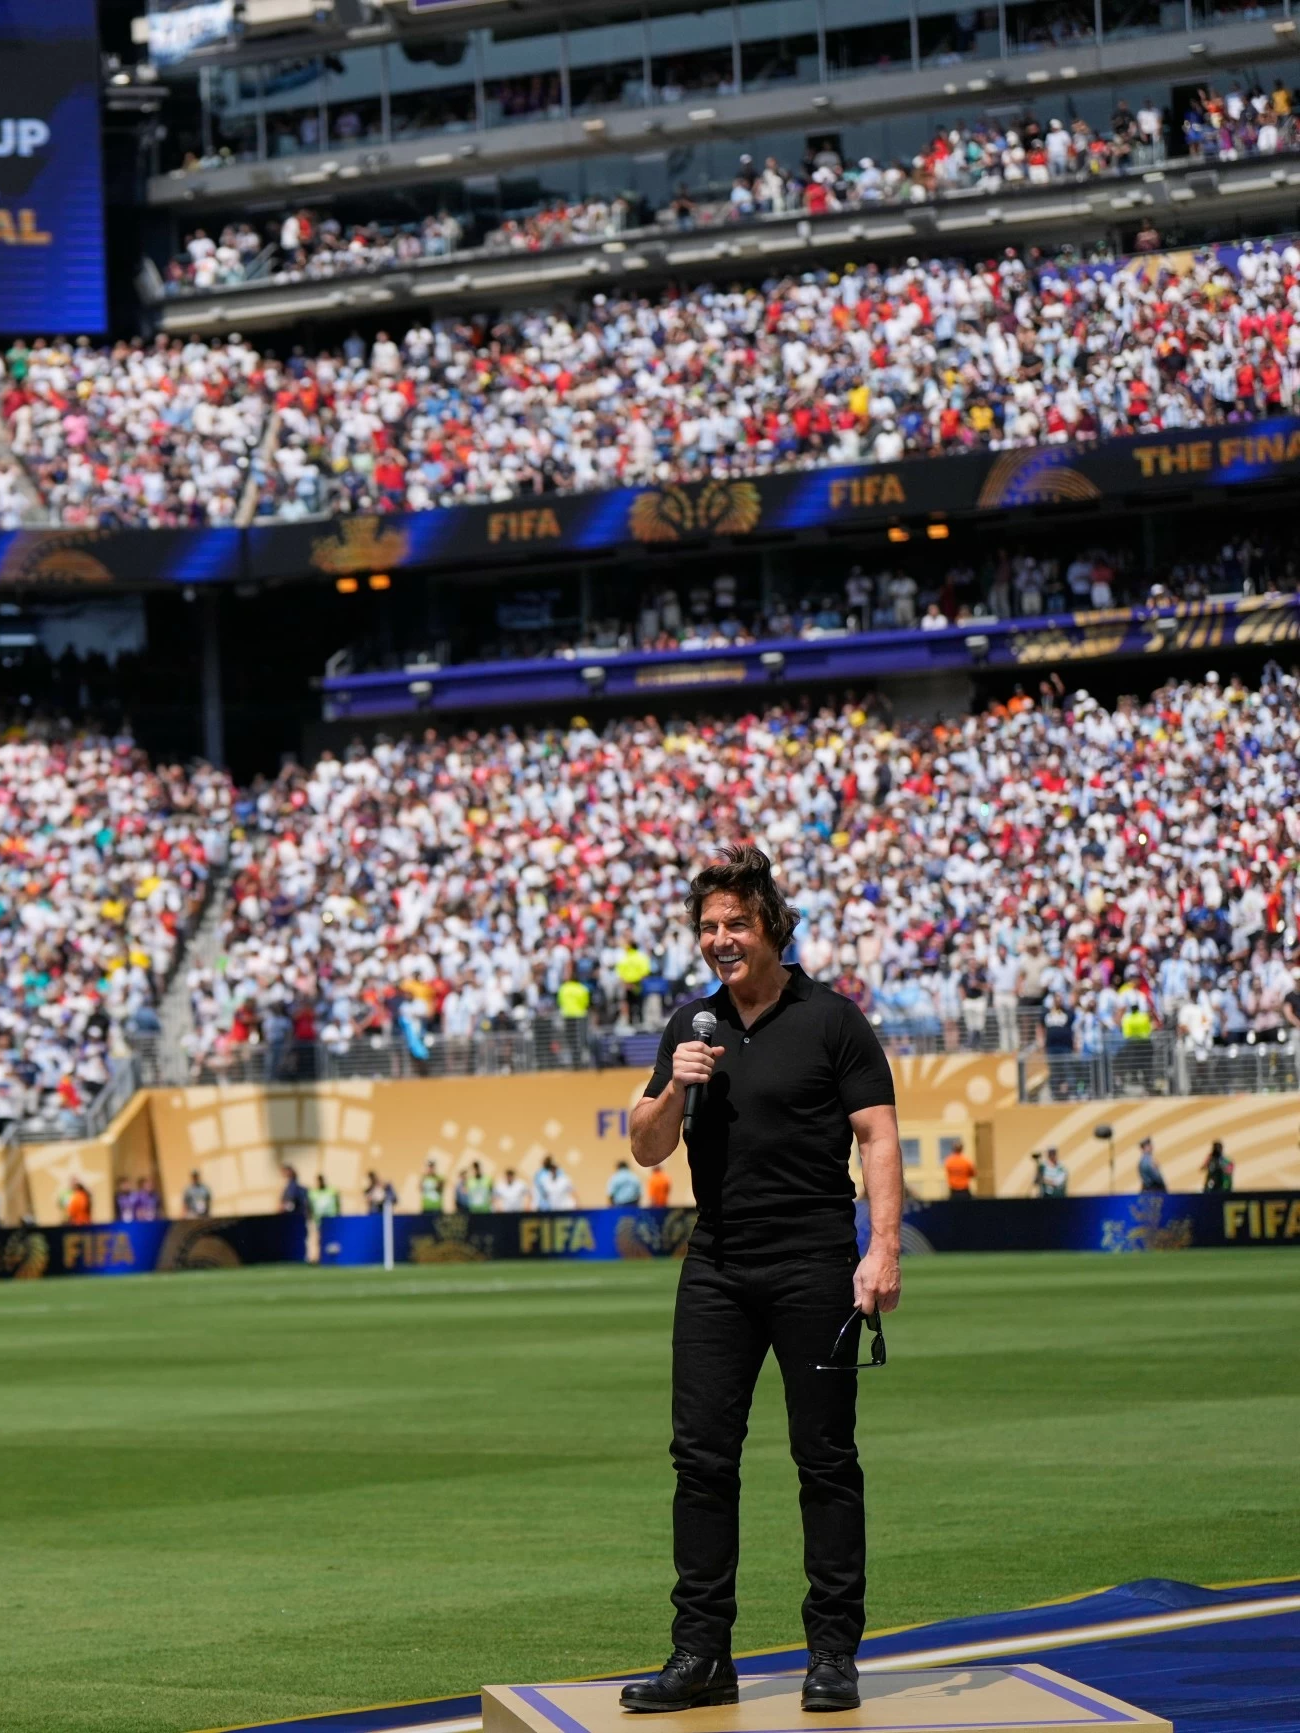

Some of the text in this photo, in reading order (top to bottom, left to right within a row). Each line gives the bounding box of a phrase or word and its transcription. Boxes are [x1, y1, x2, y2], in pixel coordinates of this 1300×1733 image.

[1133, 429, 1300, 478] THE FINA
[829, 473, 906, 507] FIFA
[488, 508, 561, 542] FIFA
[596, 1108, 628, 1138] FI
[62, 1231, 136, 1268] FIFA
[520, 1217, 595, 1254] FIFA
